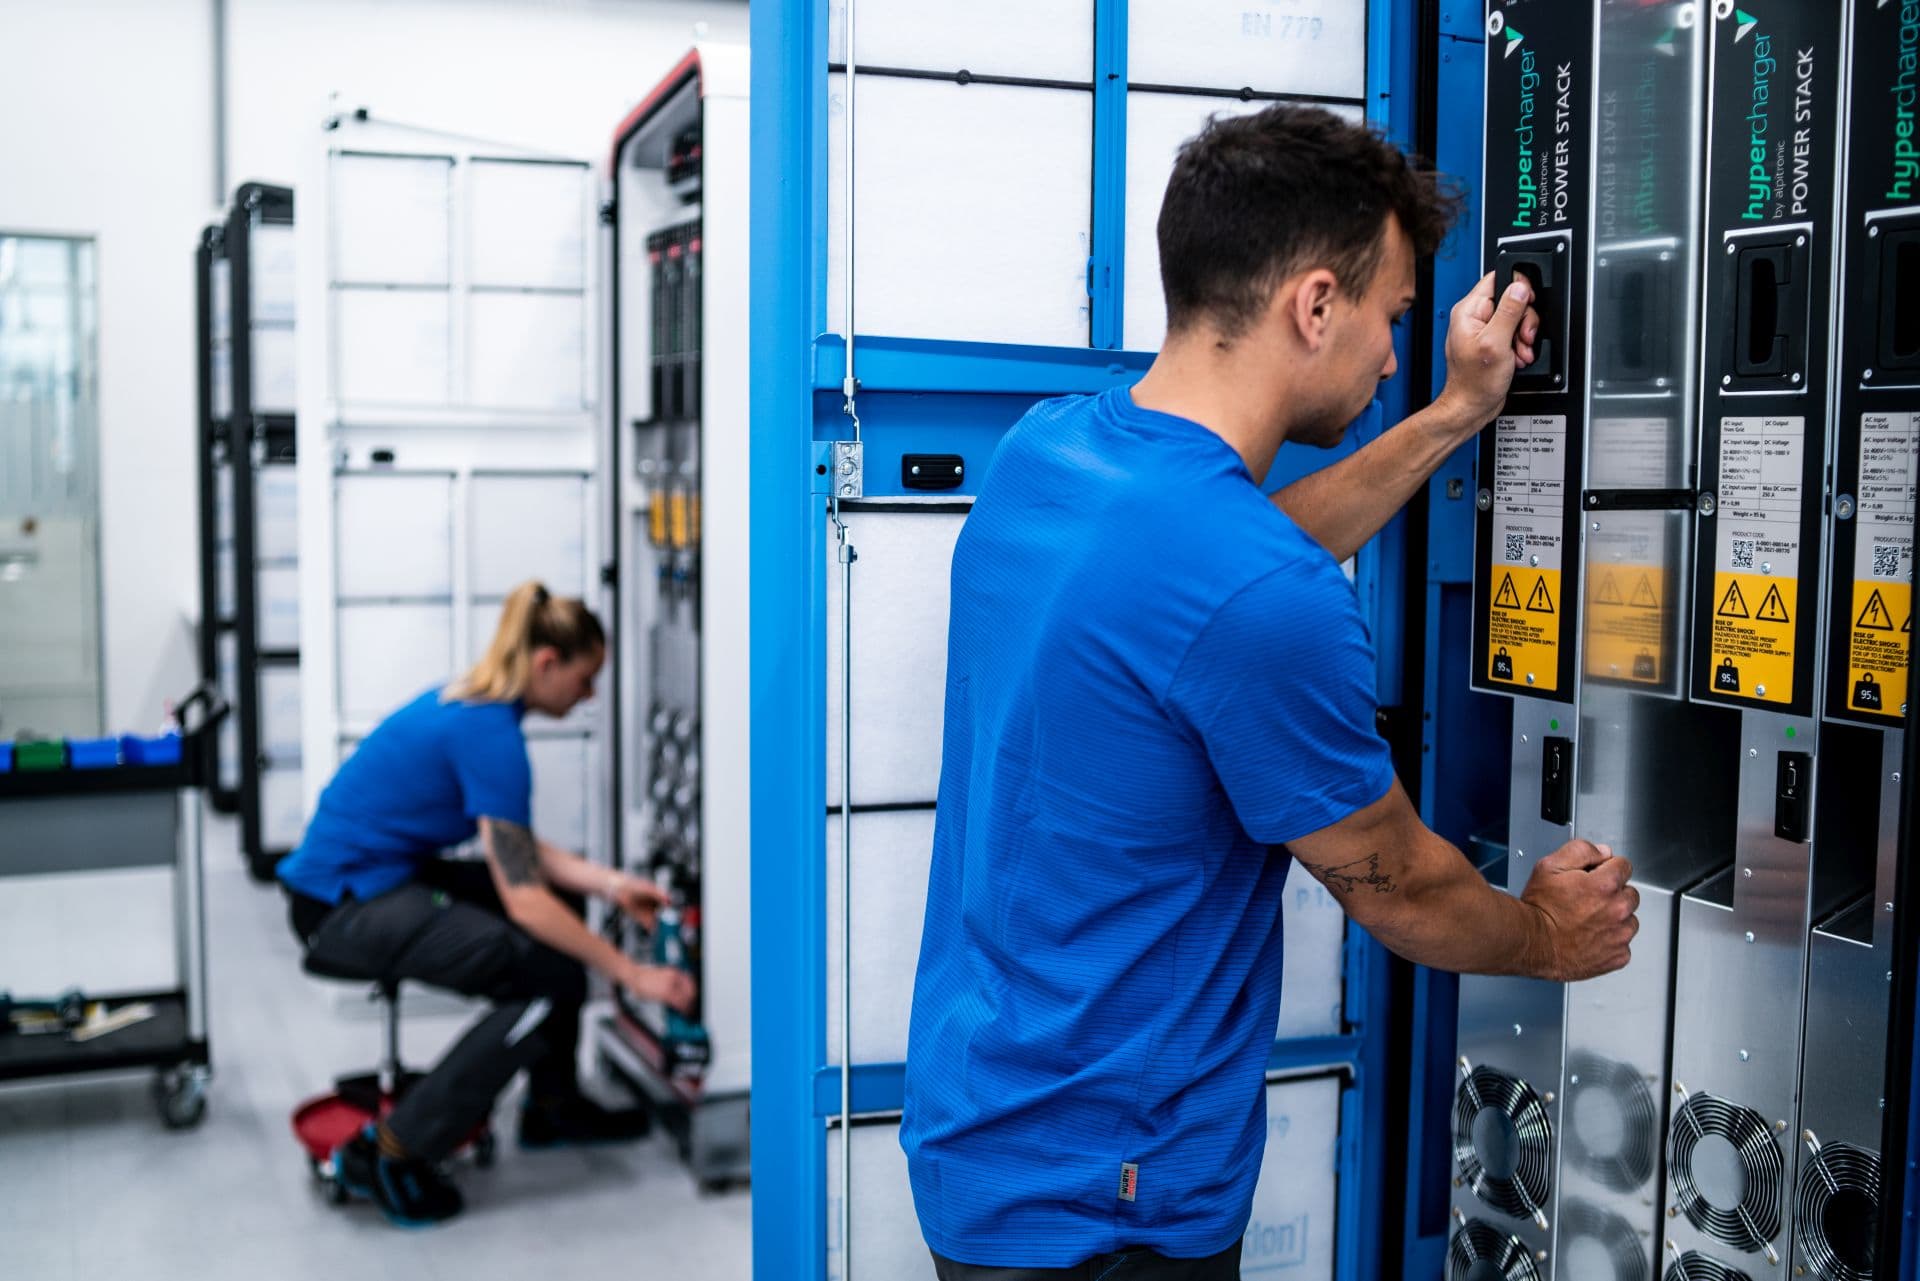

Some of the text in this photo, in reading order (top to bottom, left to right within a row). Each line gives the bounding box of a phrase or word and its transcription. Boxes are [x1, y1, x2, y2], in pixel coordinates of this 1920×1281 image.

[1512, 48, 1540, 227] hypercharger
[1741, 32, 1776, 219] hypercharger
[1791, 46, 1814, 215] POWER STACK
[1886, 0, 1920, 199] hypercharge
[1554, 61, 1571, 222] POWER STACK
[1772, 140, 1786, 219] by alpitronic
[1538, 151, 1549, 226] by alpitronic
[1875, 514, 1893, 522] Weight
[1498, 662, 1506, 671] 95
[1721, 673, 1731, 683] 95
[1861, 690, 1872, 700] 95
